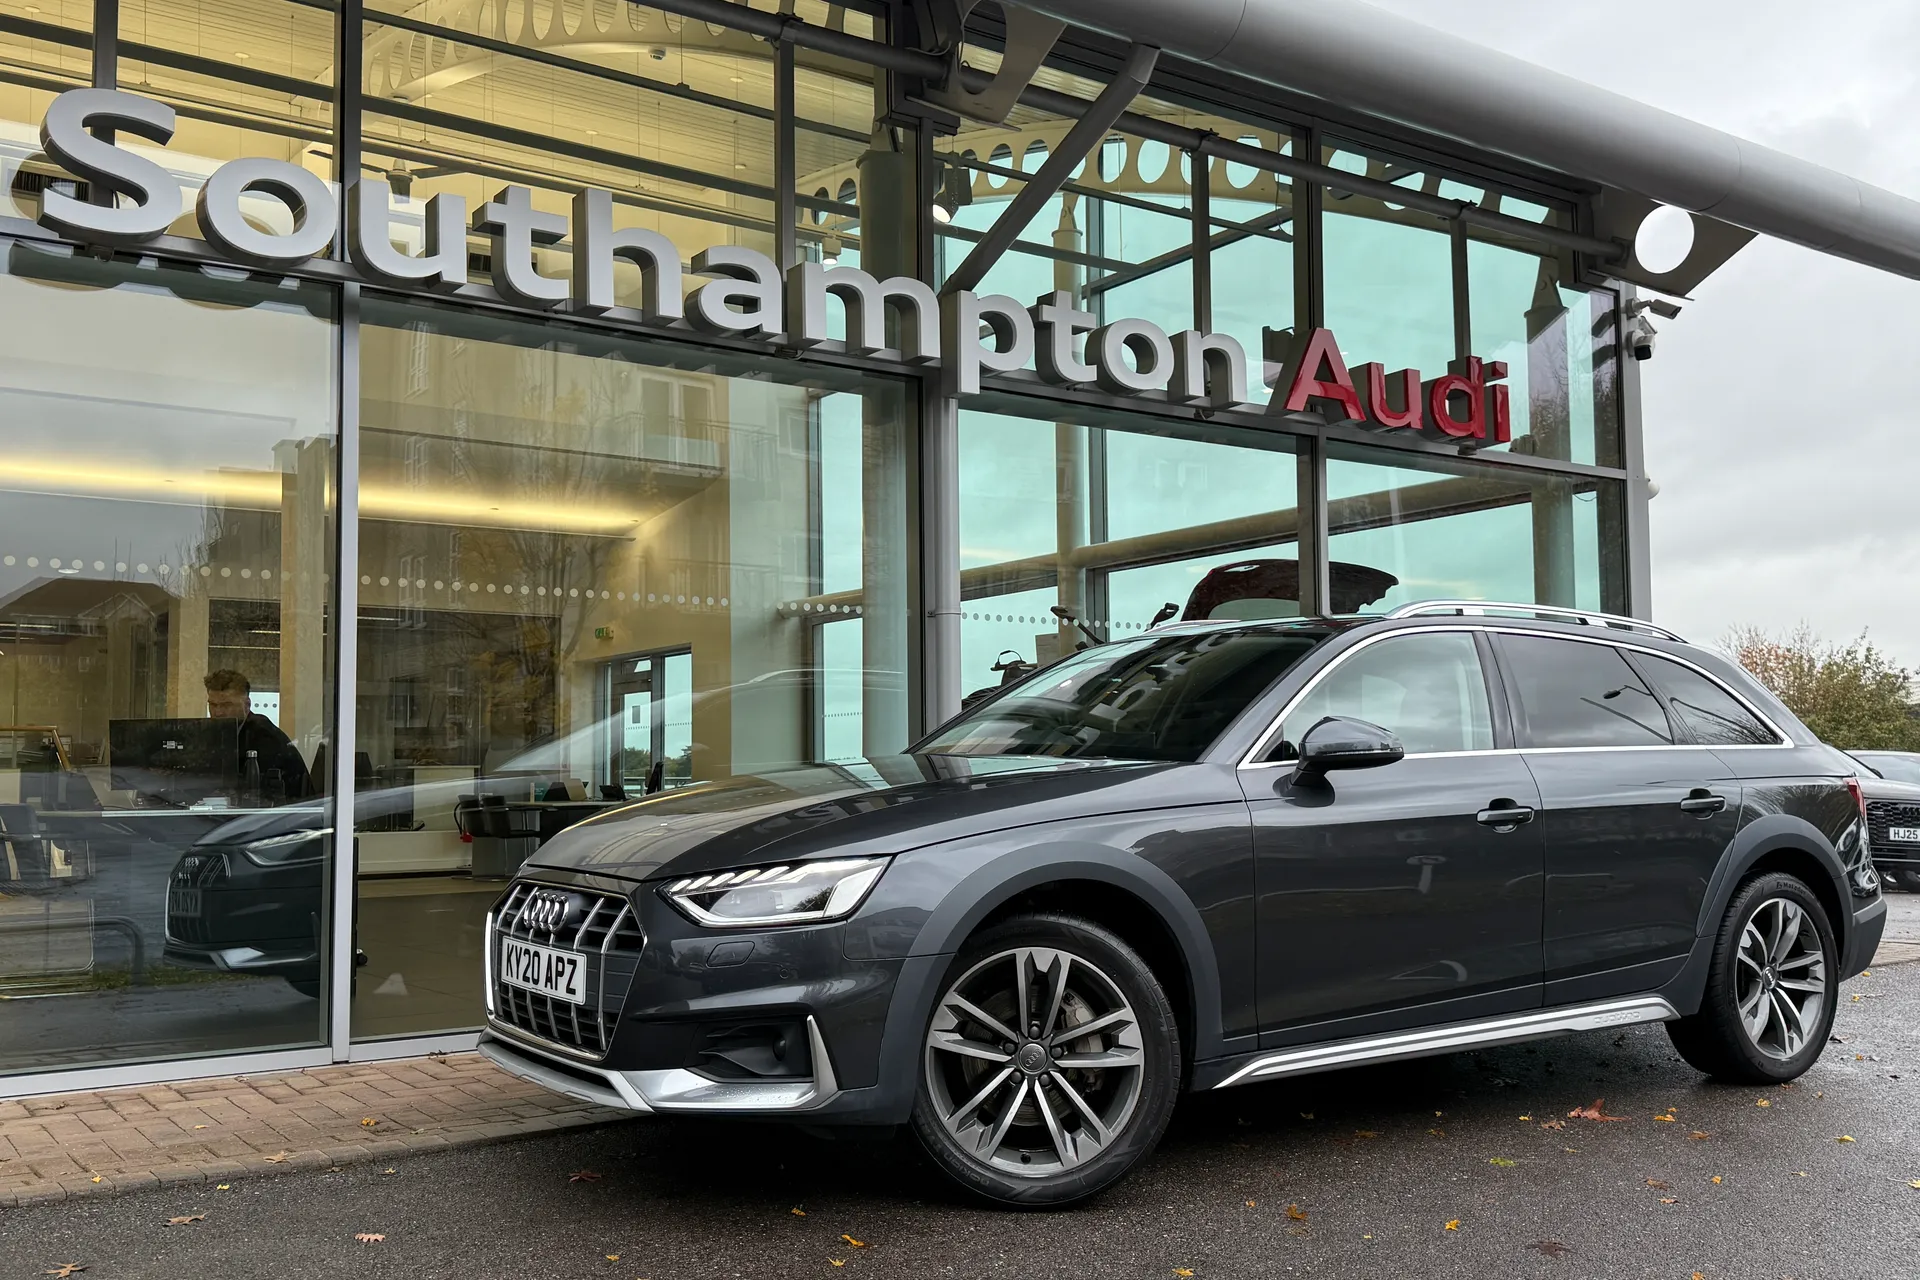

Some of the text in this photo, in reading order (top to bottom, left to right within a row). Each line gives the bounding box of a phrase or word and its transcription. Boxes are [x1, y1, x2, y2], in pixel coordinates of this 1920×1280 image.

[38, 88, 1511, 442] Southampton Audi
[1893, 828, 1919, 840] HJ25
[506, 943, 577, 995] KY20 APZ
